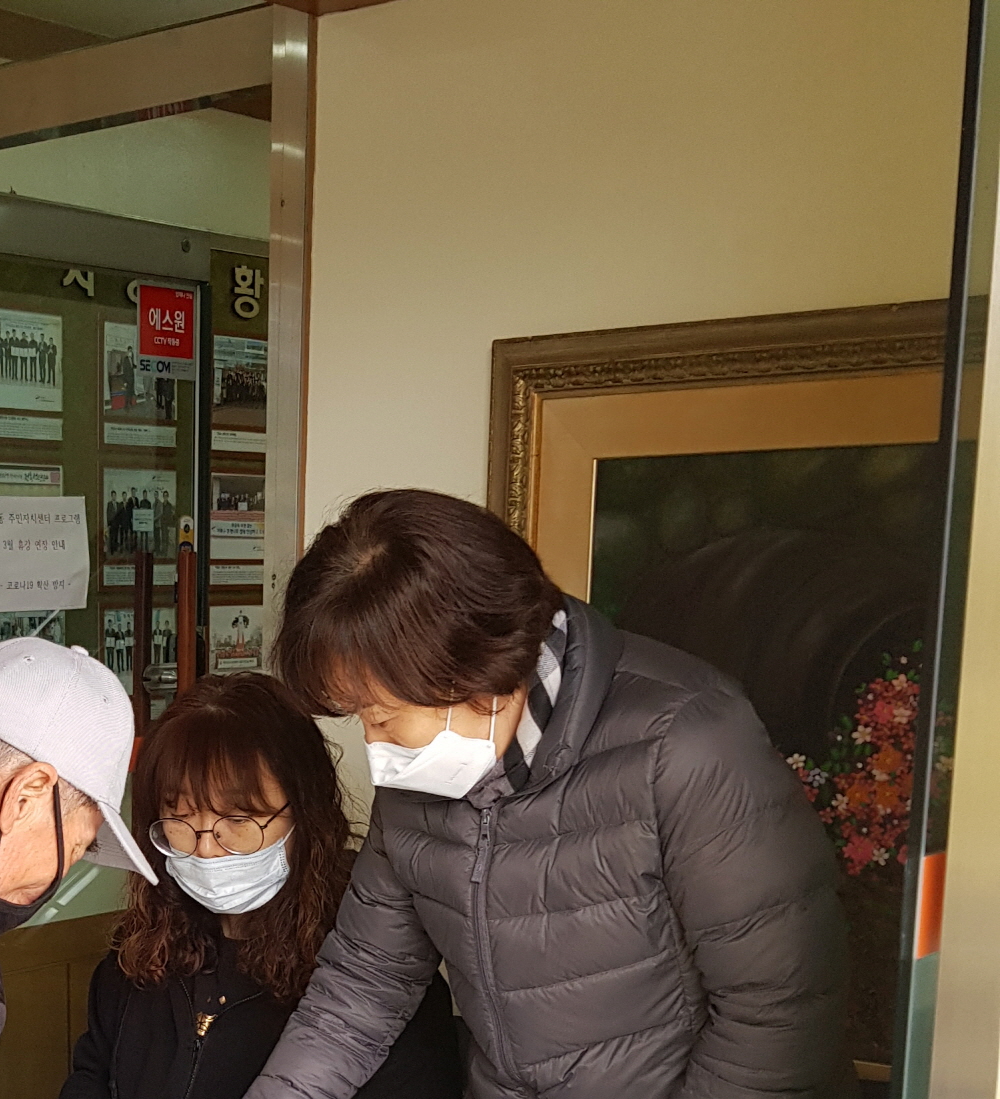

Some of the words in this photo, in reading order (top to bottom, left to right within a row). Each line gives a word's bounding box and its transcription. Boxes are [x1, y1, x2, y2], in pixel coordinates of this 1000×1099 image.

[234, 265, 264, 319] 황
[149, 307, 185, 334] 에스원
[153, 336, 167, 346] CCTV
[8, 512, 51, 525] 주민자치센터
[54, 513, 81, 525] 프로그램
[2, 540, 14, 551] 3월
[6, 581, 34, 590] 코로나19
[37, 580, 49, 590] 확산
[52, 580, 65, 590] 방지
